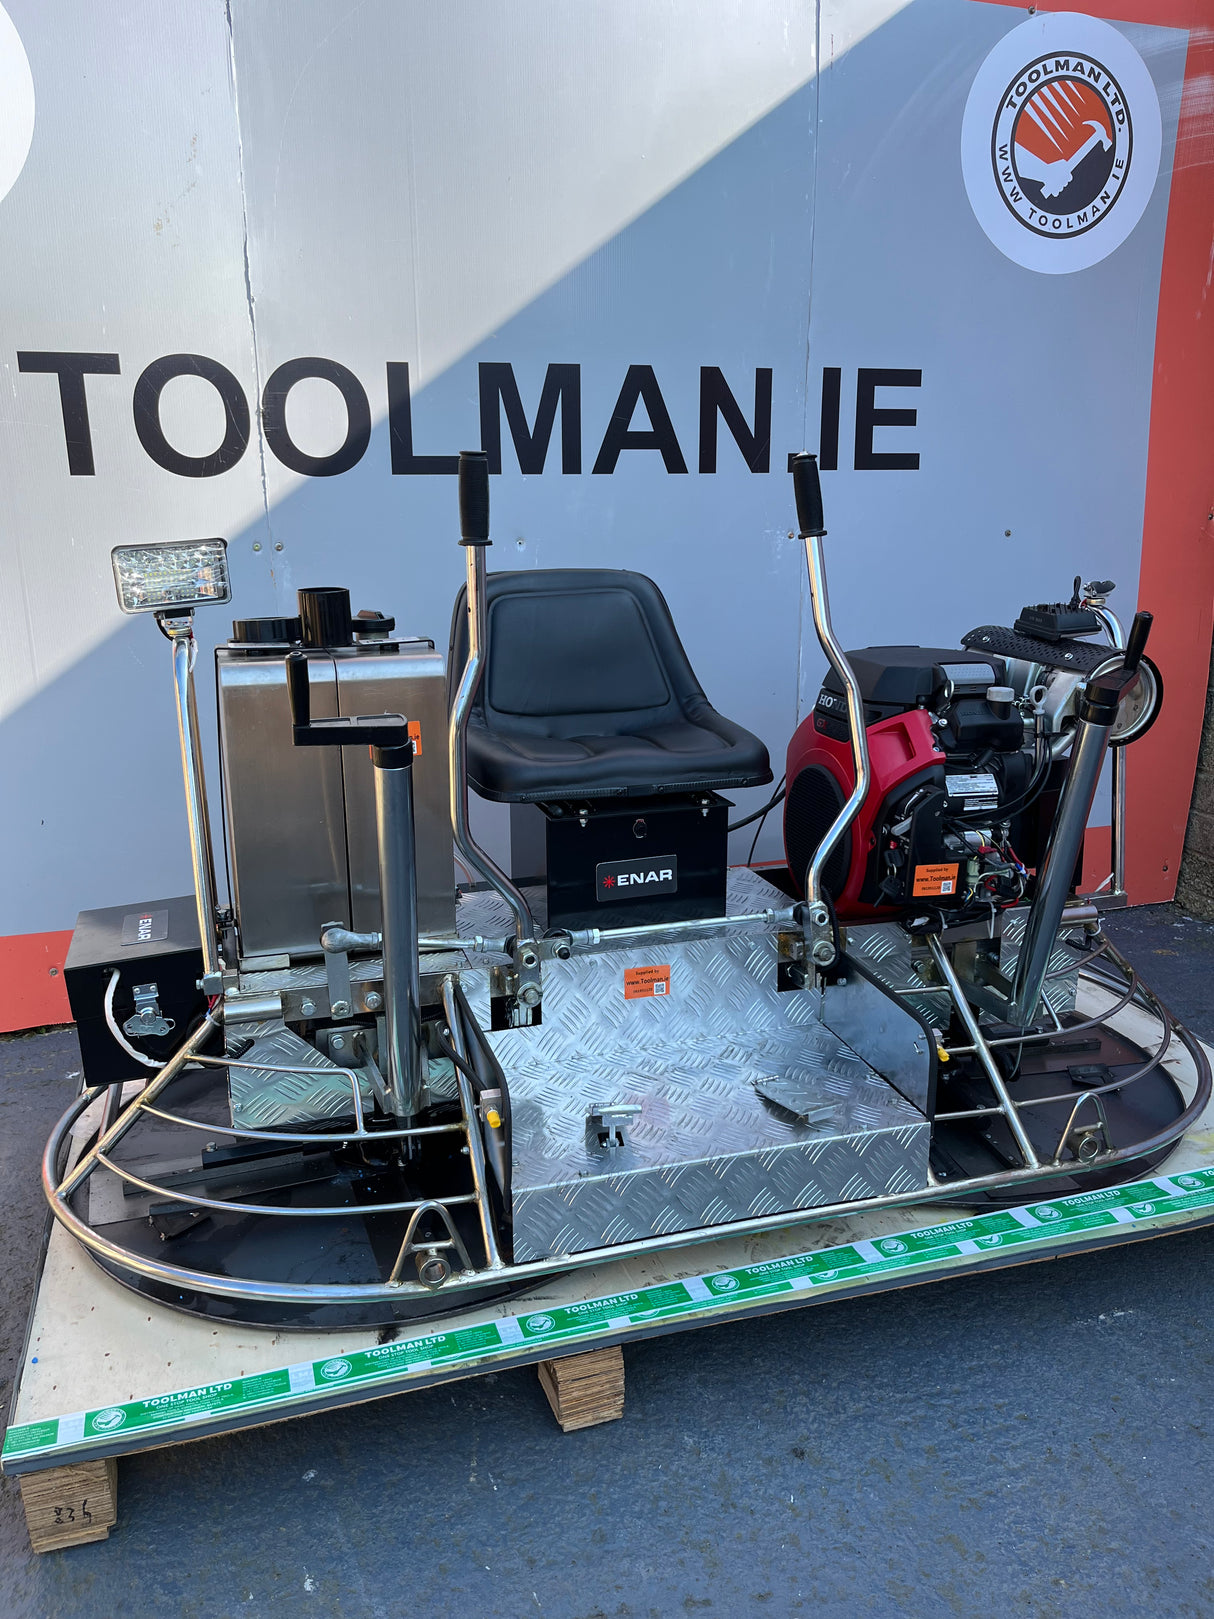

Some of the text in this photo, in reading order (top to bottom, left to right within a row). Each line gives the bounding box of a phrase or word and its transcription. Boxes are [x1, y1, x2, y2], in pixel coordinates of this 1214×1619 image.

[1006, 59, 1102, 110] TOOLMAN
[1028, 190, 1111, 230] TOOLMAN
[617, 869, 672, 886] ENAR
[138, 918, 152, 940] ENAR
[910, 1225, 956, 1239] TOOLMAN
[745, 1260, 794, 1275] TOOLMAN
[795, 1256, 813, 1264] LTD
[564, 1298, 618, 1314] TOOLMAN
[618, 1294, 638, 1302] LTD
[365, 1340, 423, 1358] TOOLMAN
[425, 1336, 446, 1344] LTD
[142, 1388, 206, 1408] TOOLMAN
[210, 1383, 232, 1393] LTD
